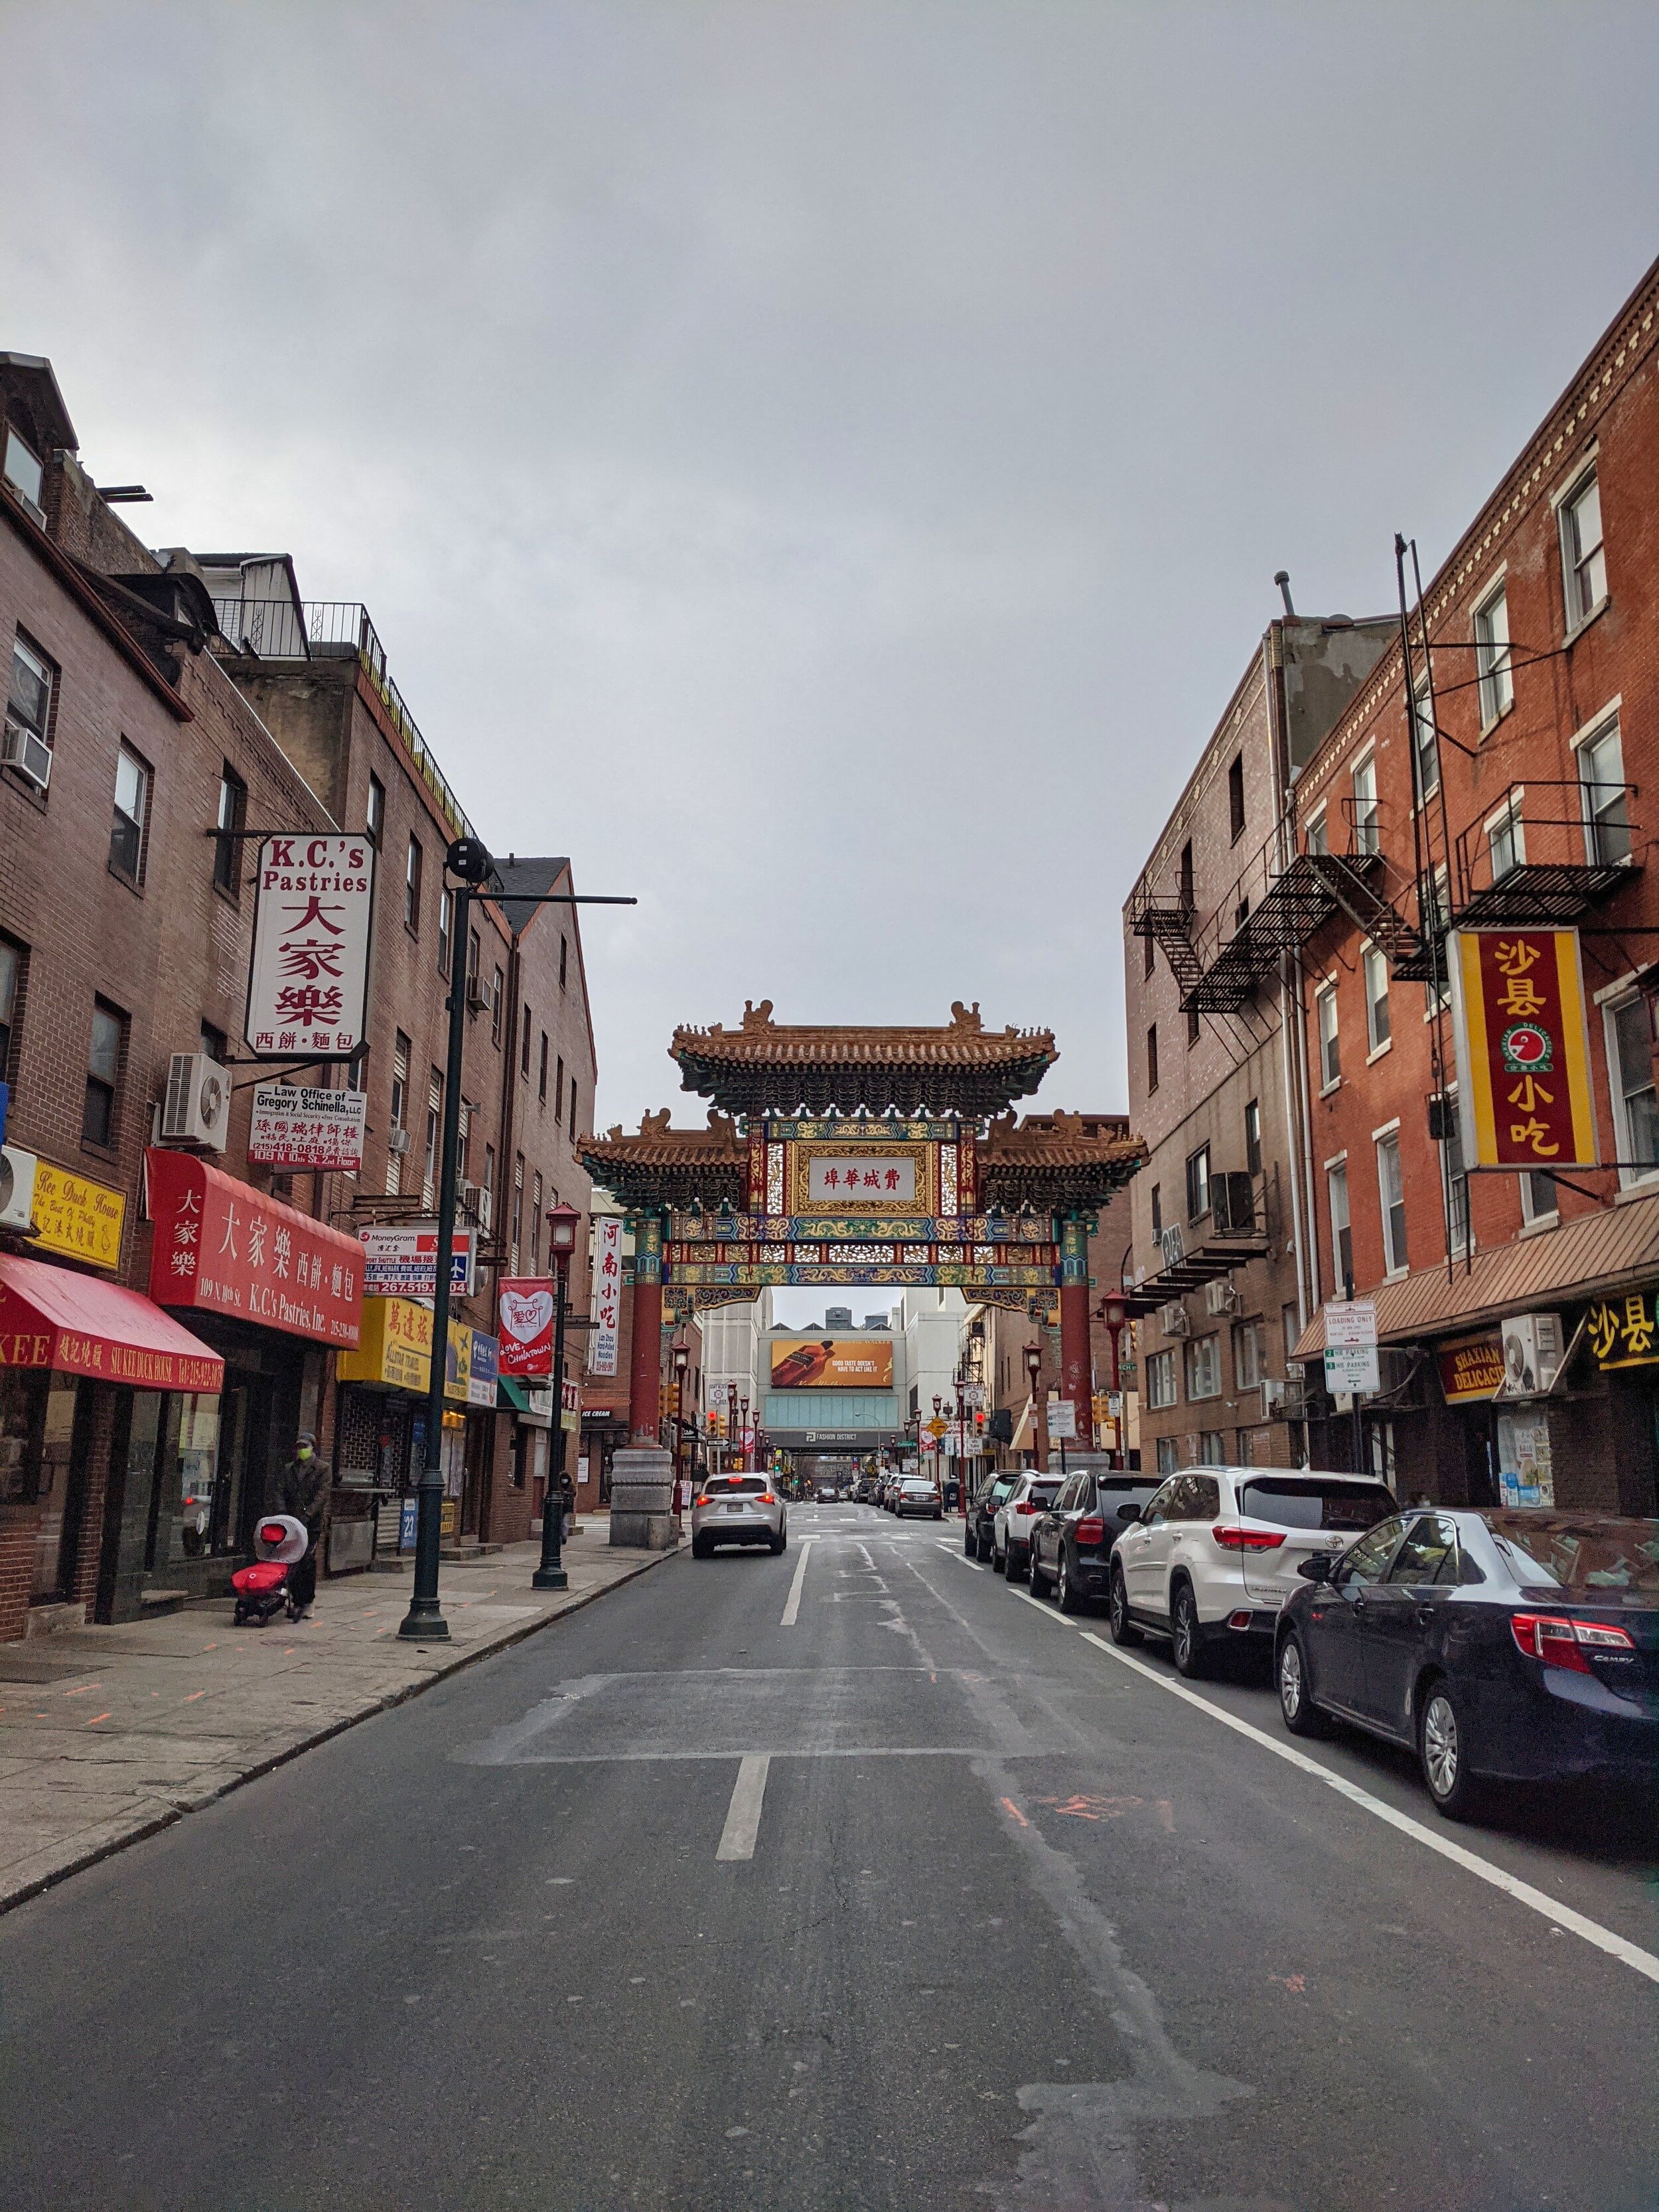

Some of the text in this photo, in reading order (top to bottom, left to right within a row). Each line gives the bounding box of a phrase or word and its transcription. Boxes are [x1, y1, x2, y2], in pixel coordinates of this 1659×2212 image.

[269, 840, 364, 868] K.C.'s
[263, 871, 368, 893] Pastries
[274, 895, 346, 1027] 大家樂
[1494, 938, 1559, 1156] 沙县 小吃
[257, 1094, 298, 1111] Gregory
[302, 1098, 349, 1115] Schinella,
[274, 1086, 346, 1102] Law Office of
[254, 1150, 274, 1160] 109
[277, 1153, 285, 1161] N
[289, 1153, 305, 1163] 10th
[322, 1156, 334, 1165] 2nd
[336, 1157, 356, 1166] Floor
[171, 1189, 202, 1276] 大家樂
[218, 1202, 292, 1279] 大家樂
[600, 1223, 620, 1329] 河南小吃
[200, 1277, 213, 1297] 109
[249, 1283, 277, 1318] K.C.'s
[312, 1305, 325, 1333] Inc.
[1329, 1316, 1354, 1325] LOADING
[1587, 1294, 1654, 1359] 沙县
[123, 1349, 137, 1378] KEE
[137, 1351, 154, 1380] DUCK
[155, 1355, 173, 1382] HOUSE
[508, 1342, 551, 1364] CHINATOWN
[1455, 1347, 1501, 1372] SHAXIAN
[1454, 1364, 1505, 1390] DELICACIE
